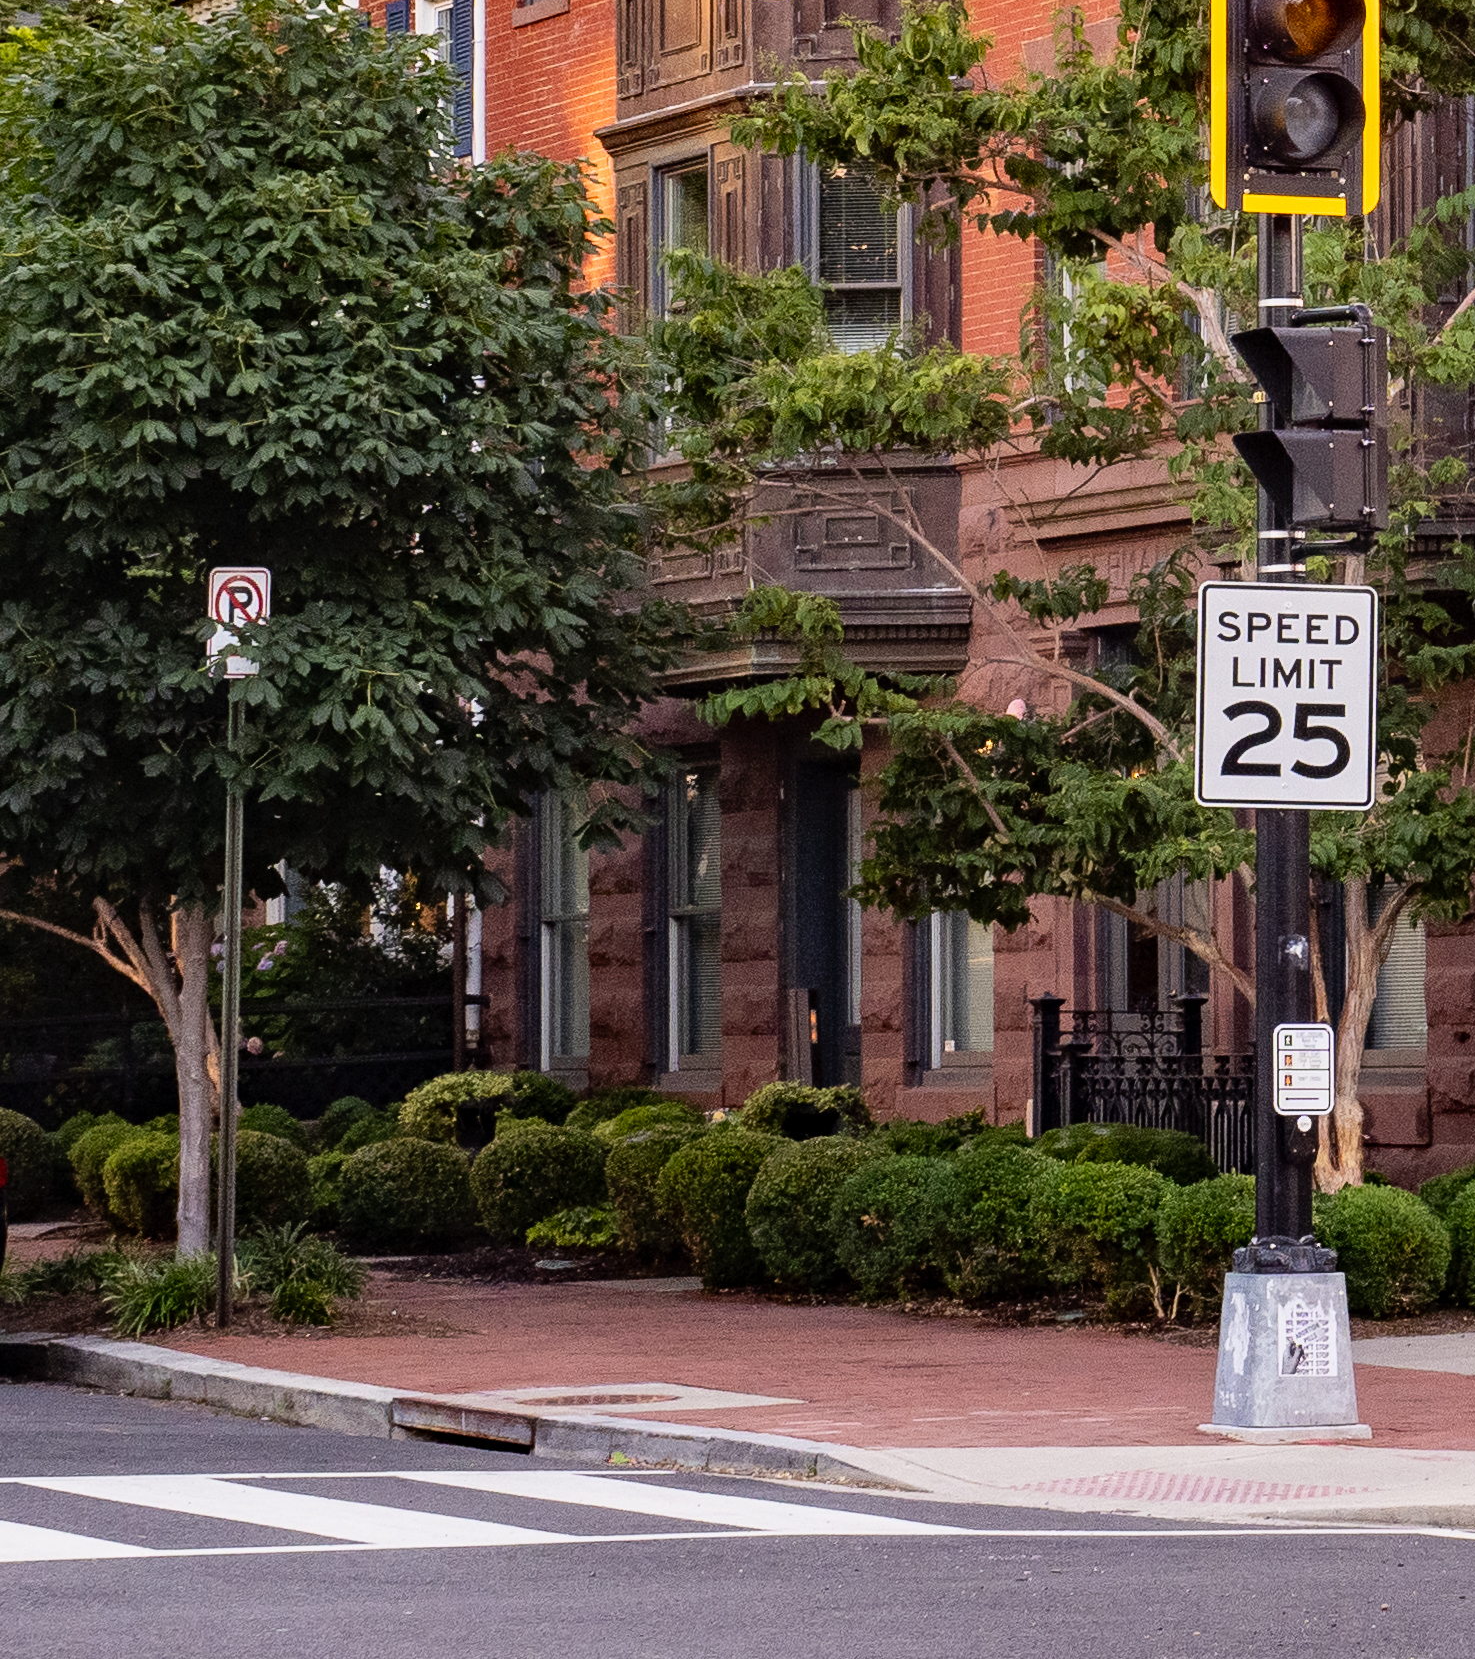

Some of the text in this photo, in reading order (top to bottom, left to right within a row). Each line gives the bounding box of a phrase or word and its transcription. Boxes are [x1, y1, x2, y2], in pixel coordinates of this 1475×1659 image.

[1217, 611, 1359, 645] SPEED
[1232, 657, 1342, 689] LIMIT
[1220, 700, 1351, 779] 25
